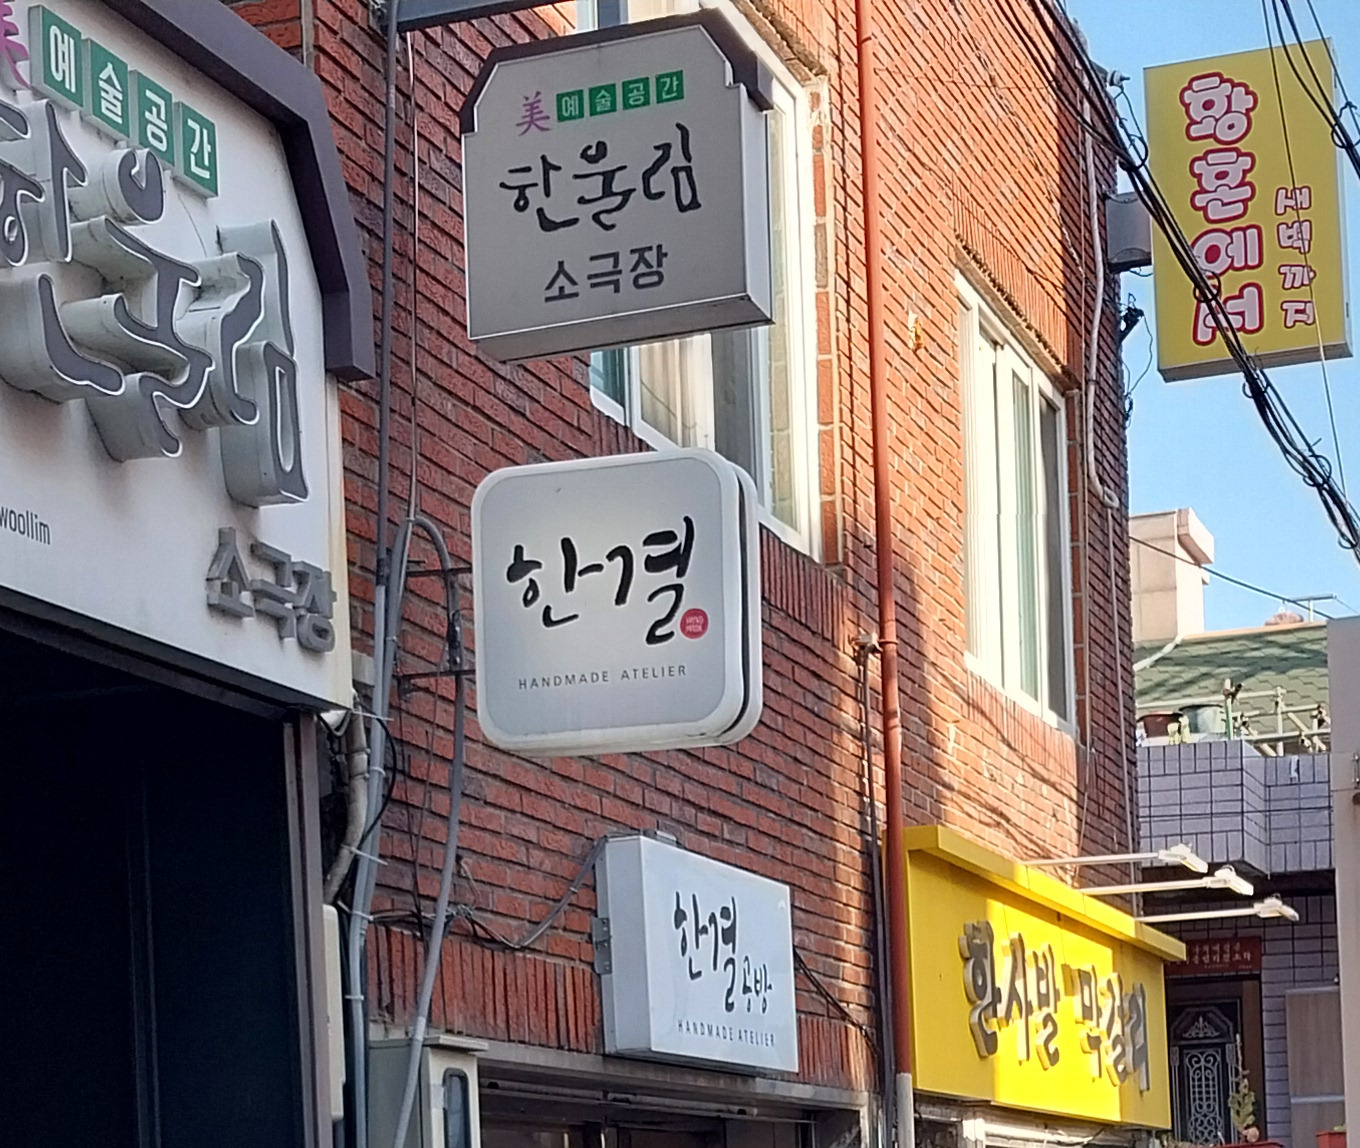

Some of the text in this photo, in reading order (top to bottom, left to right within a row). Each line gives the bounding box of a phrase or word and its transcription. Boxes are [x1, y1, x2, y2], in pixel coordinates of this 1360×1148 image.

[48, 22, 213, 181] 예술공간
[516, 92, 550, 137] 美
[559, 74, 680, 119] 예술공간
[499, 122, 702, 232] 한울림
[1179, 71, 1263, 345] 황혼에서
[544, 243, 668, 303] 소극장
[1275, 185, 1316, 329] 새벽까지
[206, 525, 337, 652] 소극장
[506, 515, 694, 645] 한결
[518, 664, 687, 690] HANDMADE ATELIER
[674, 891, 737, 1012] 한결
[678, 1019, 775, 1047] HANDMADE ATELIER
[1071, 964, 1150, 1093] 막걸리
